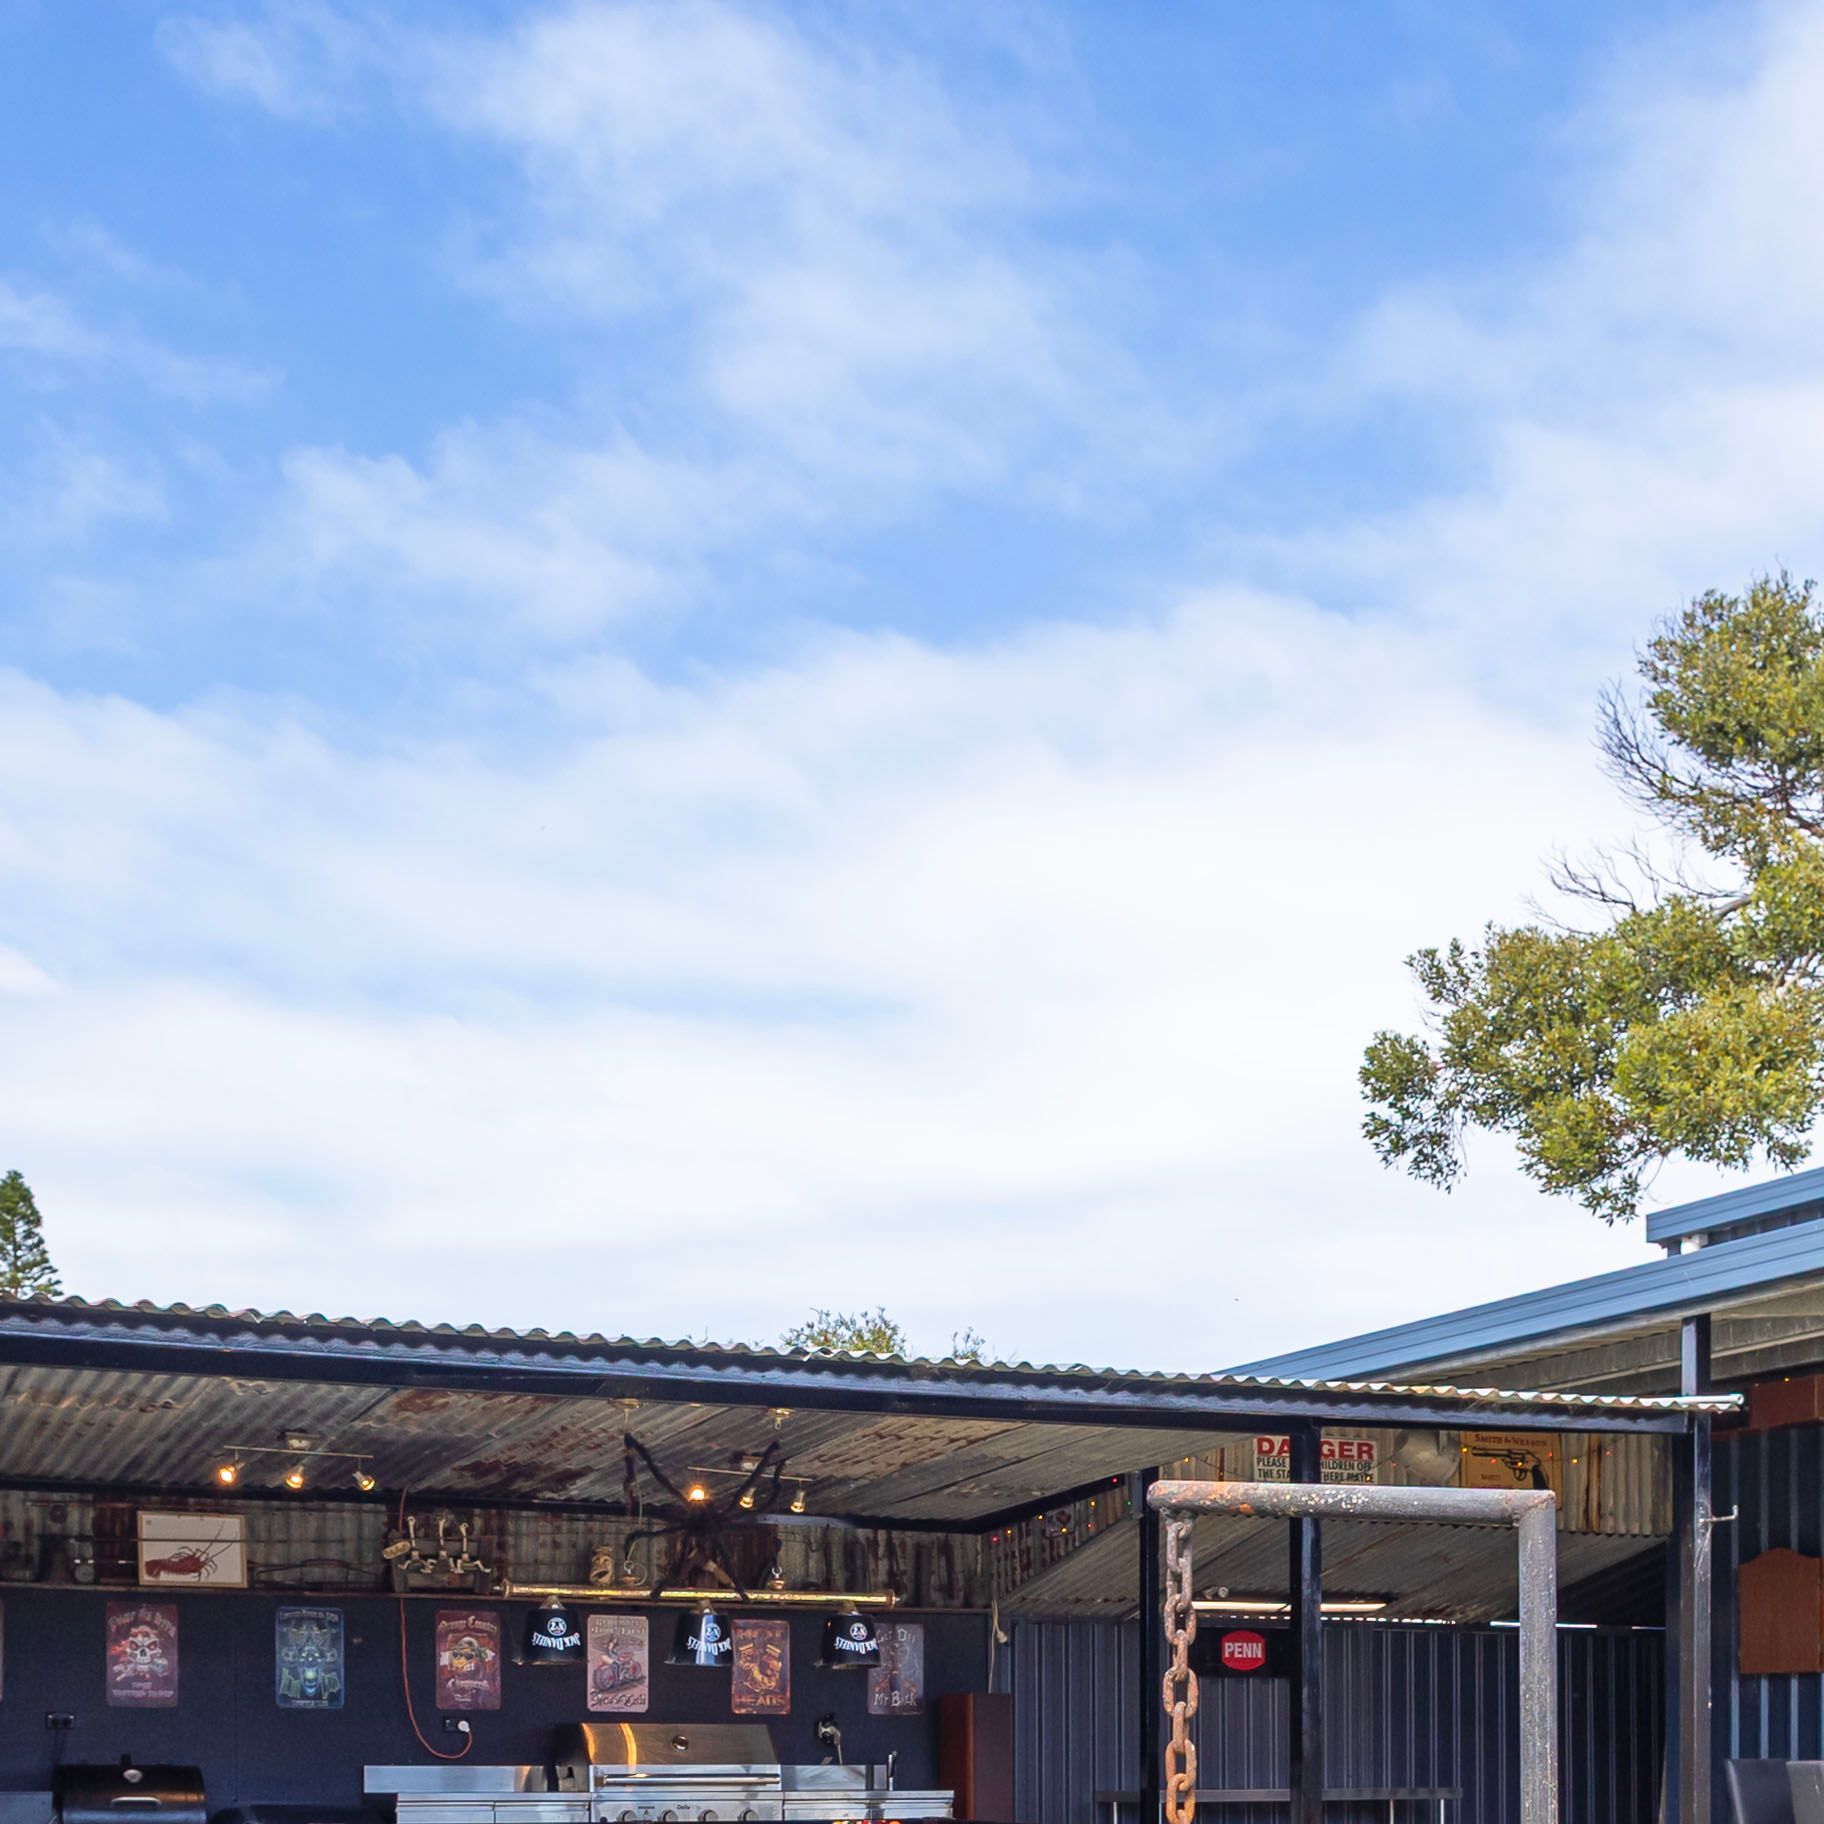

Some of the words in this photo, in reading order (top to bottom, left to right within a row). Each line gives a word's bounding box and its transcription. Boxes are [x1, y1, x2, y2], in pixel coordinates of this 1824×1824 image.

[1257, 1437, 1374, 1460] DAGER
[1257, 1457, 1286, 1468] PLEASE
[1320, 1460, 1355, 1471] HILDREN
[1258, 1468, 1274, 1478] THE
[1322, 1471, 1345, 1482] HERE
[1224, 1642, 1262, 1658] PENN
